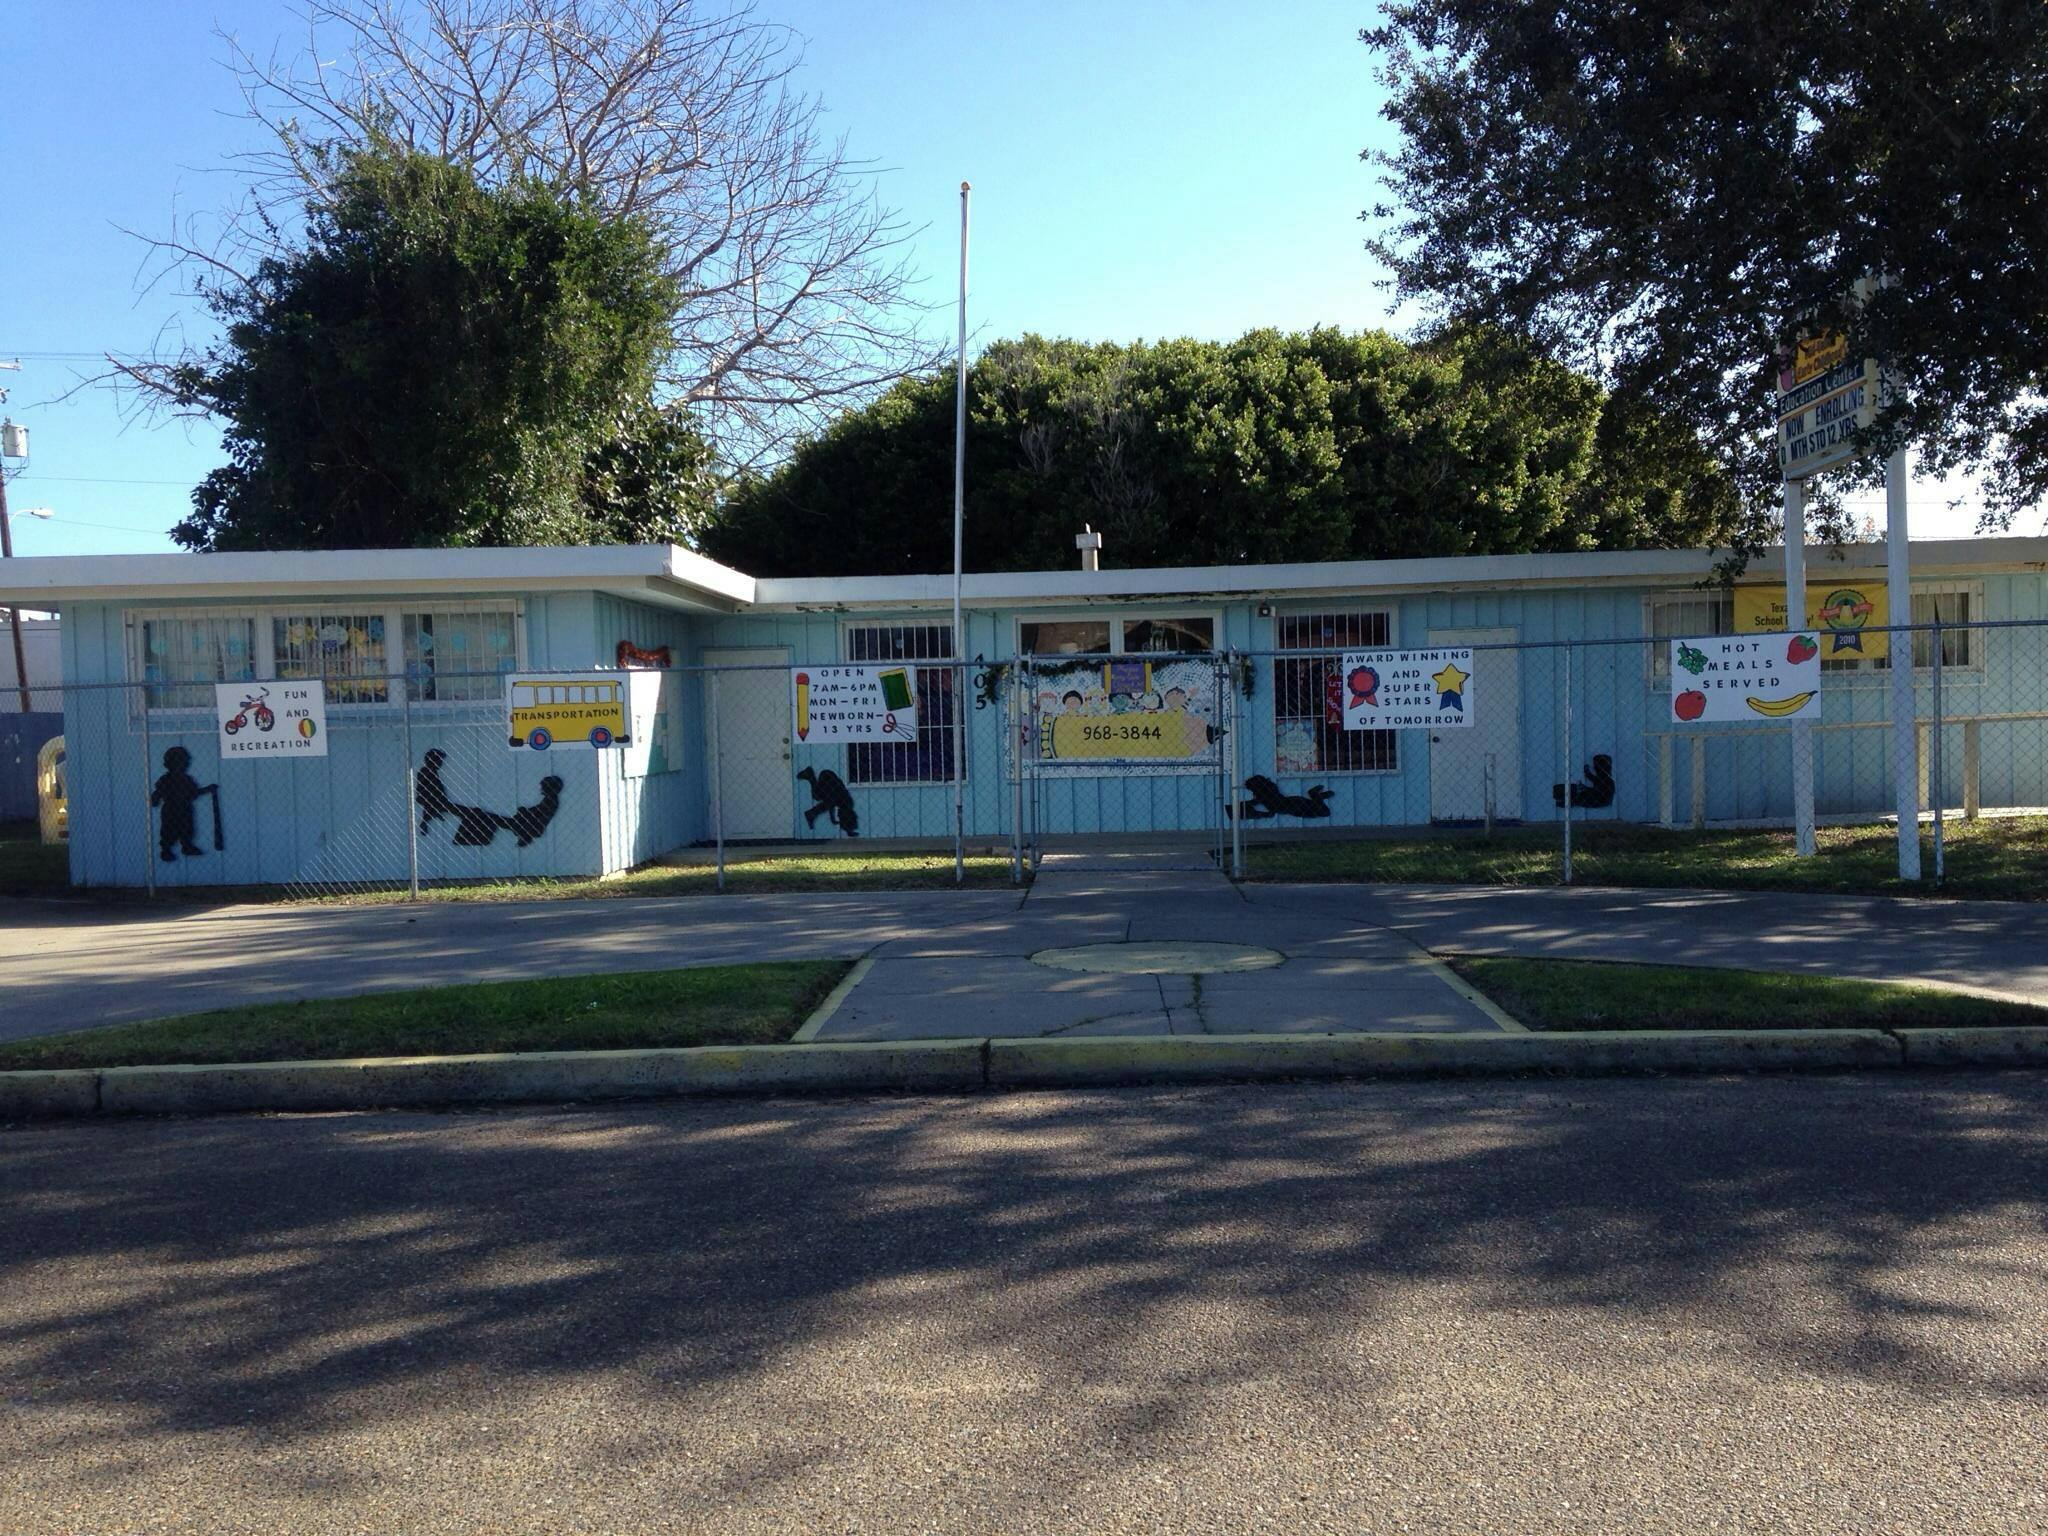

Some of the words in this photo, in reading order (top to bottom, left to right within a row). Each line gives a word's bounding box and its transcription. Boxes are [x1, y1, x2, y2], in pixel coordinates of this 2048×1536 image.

[1786, 413, 1804, 439] NOW
[1816, 386, 1864, 425] ENROLLING
[1827, 424, 1836, 445] 12
[1770, 602, 1788, 613] Texa
[1755, 616, 1783, 626] School
[1839, 634, 1856, 645] 2010
[1722, 643, 1760, 653] HOT
[1346, 653, 1394, 663] AWARD
[1400, 650, 1470, 661] WINNING
[1708, 660, 1773, 671] MEALS
[821, 668, 864, 677] OPEN
[1392, 670, 1420, 679] AND
[1384, 683, 1431, 692] SUPER
[1703, 678, 1780, 689] SERVED
[284, 690, 308, 699] FUN
[1384, 696, 1431, 706] STARS
[286, 709, 309, 718] AND
[514, 708, 619, 720] TRANSPORTATION
[1359, 716, 1376, 725] OF
[1385, 715, 1464, 725] TOMORROW
[823, 725, 838, 734] 13
[846, 725, 872, 733] YRS
[1083, 725, 1162, 740] 968-3844
[231, 739, 311, 751] RECREATION
